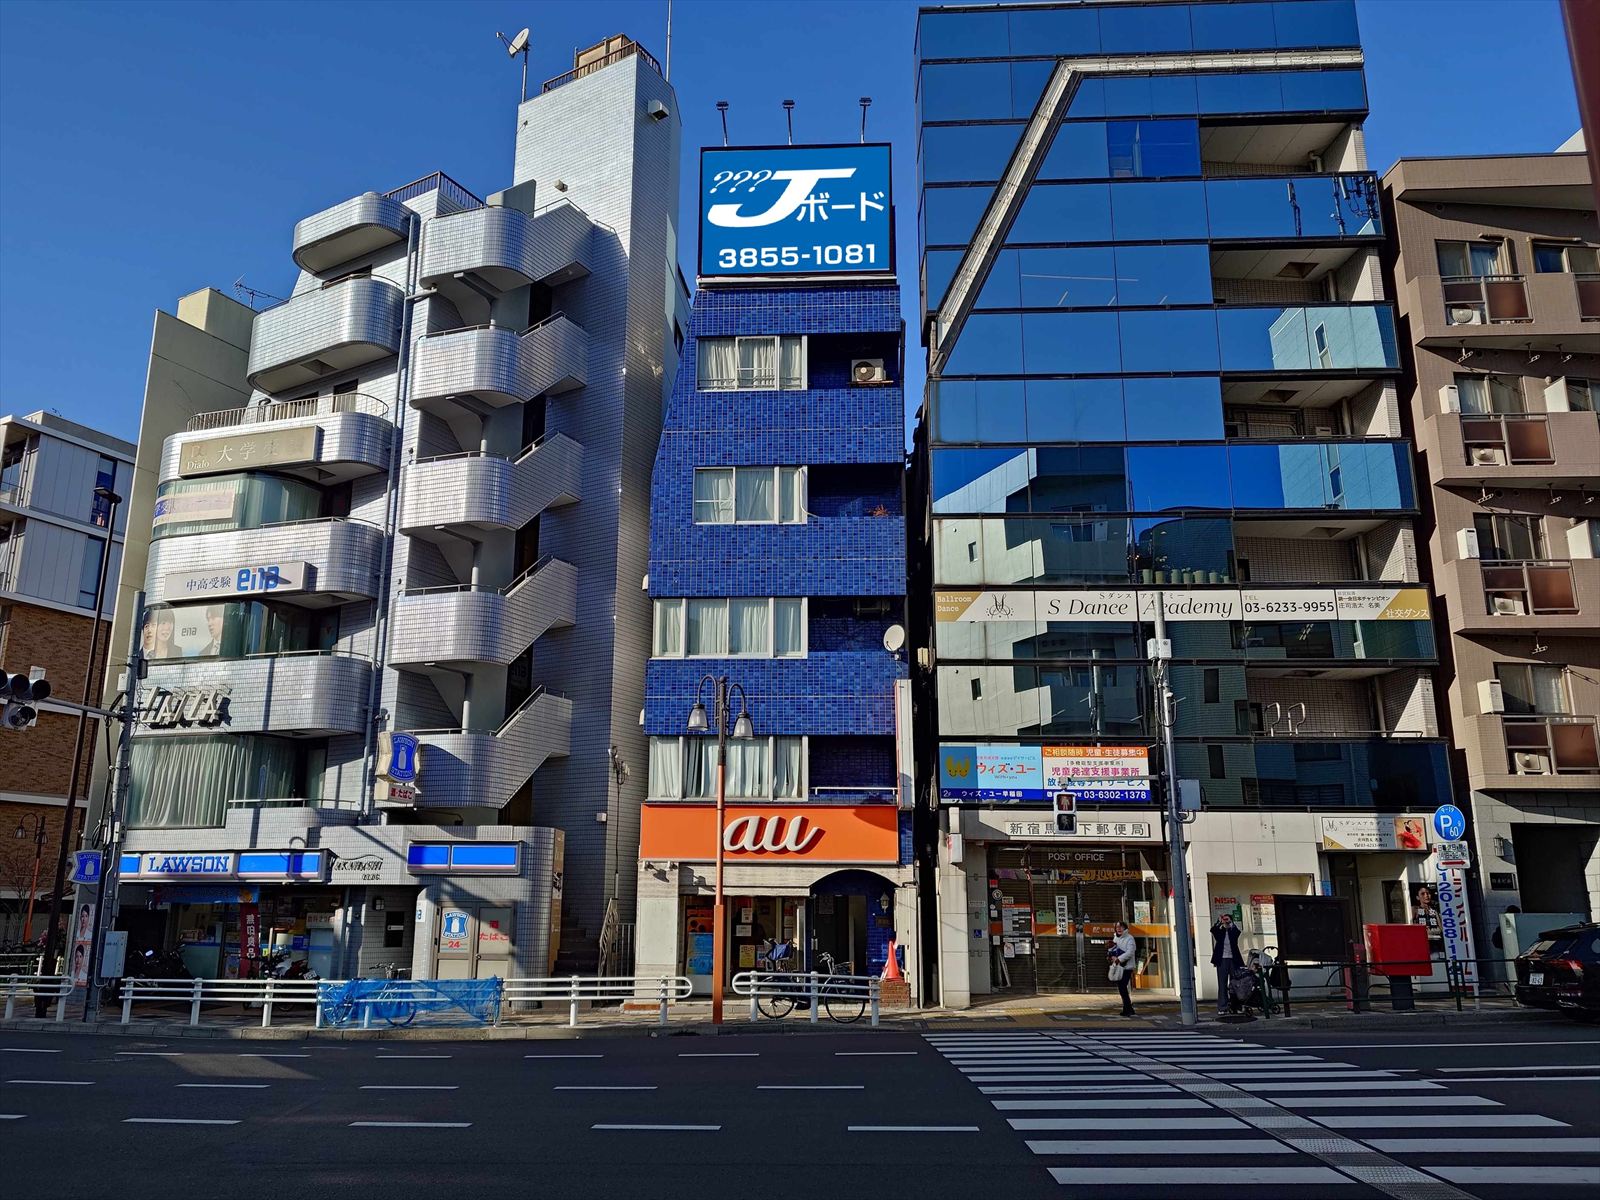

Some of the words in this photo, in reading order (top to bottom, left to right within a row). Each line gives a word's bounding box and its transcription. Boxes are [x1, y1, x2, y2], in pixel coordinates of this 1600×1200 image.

[718, 244, 876, 268] 3855-1081
[185, 575, 232, 592] 中高受験
[937, 595, 972, 603] Ballroom
[1047, 599, 1061, 615] S
[1069, 598, 1128, 615] Dance
[1244, 601, 1335, 613] 03-6233-9955
[1386, 608, 1430, 618] 社交ダンス
[180, 626, 197, 637] ena
[976, 762, 1036, 774] ウィズ・ユー
[1051, 767, 1140, 776] 児童発達支援事業所
[1083, 791, 1147, 799] 03-6302-1378
[1009, 823, 1145, 836] 新宿馬下郵便局
[1440, 815, 1453, 838] P
[723, 815, 824, 853] au
[1048, 853, 1070, 861] POST
[1074, 853, 1105, 861] OFFICE
[149, 855, 230, 873] LAWSON
[445, 911, 467, 919] LAWSON
[246, 914, 256, 960] 無印良品
[479, 932, 510, 941] たばこ
[448, 940, 461, 949] 24
